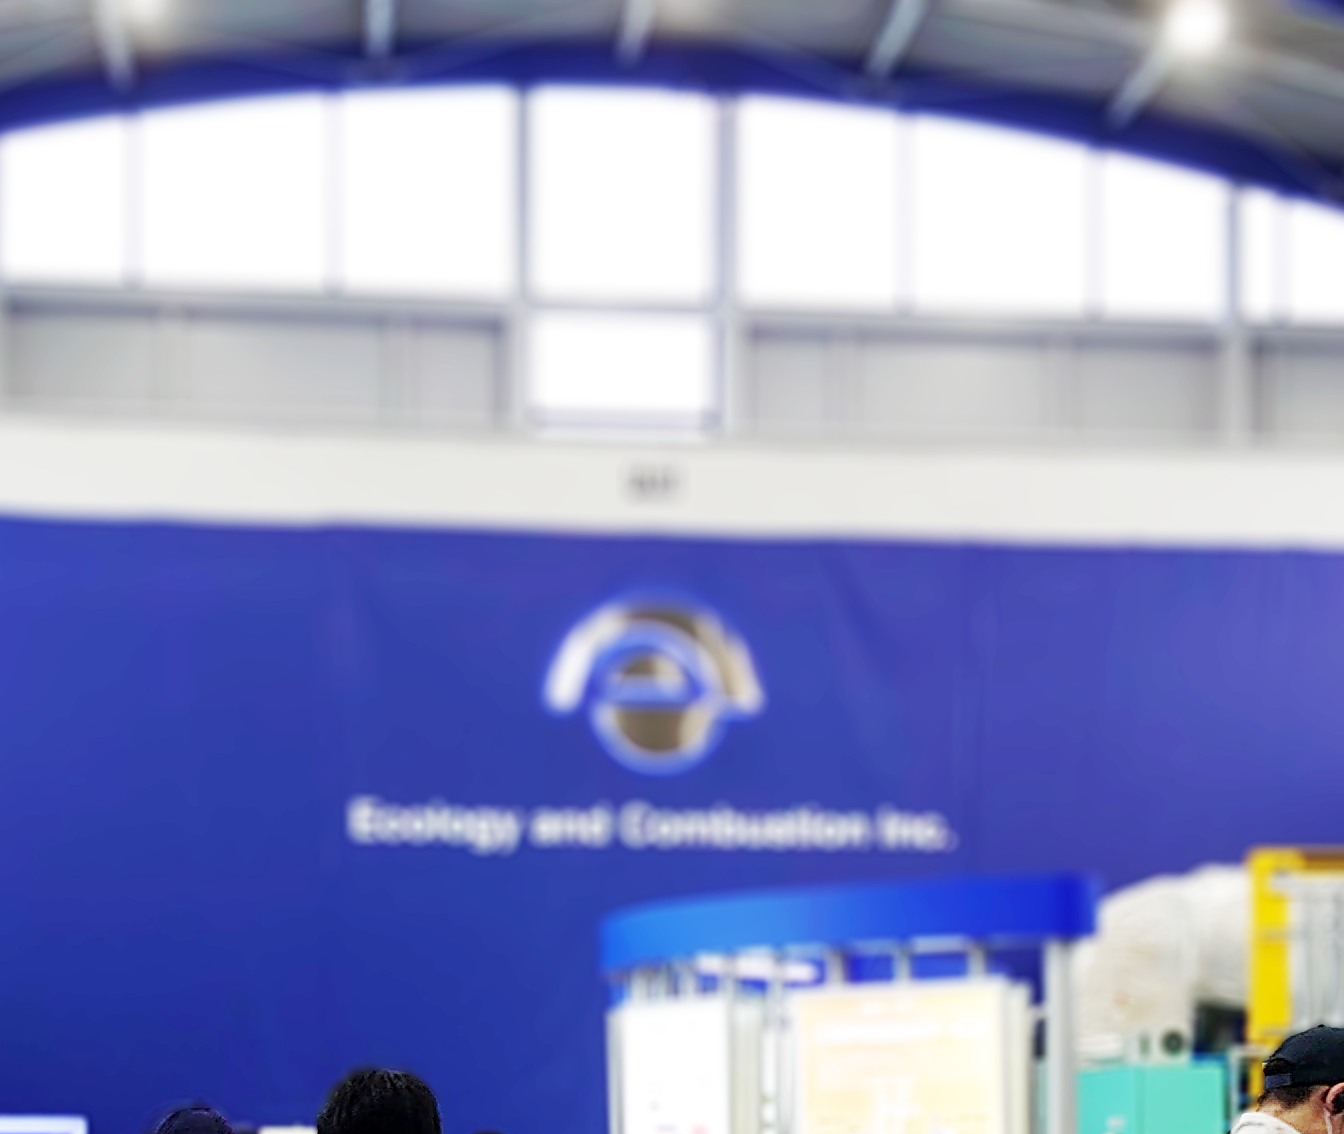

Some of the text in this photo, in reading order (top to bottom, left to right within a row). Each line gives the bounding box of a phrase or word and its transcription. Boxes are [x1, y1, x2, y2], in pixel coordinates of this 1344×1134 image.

[348, 798, 520, 855] Ecology
[532, 801, 612, 848] and
[620, 800, 870, 850] Combustion
